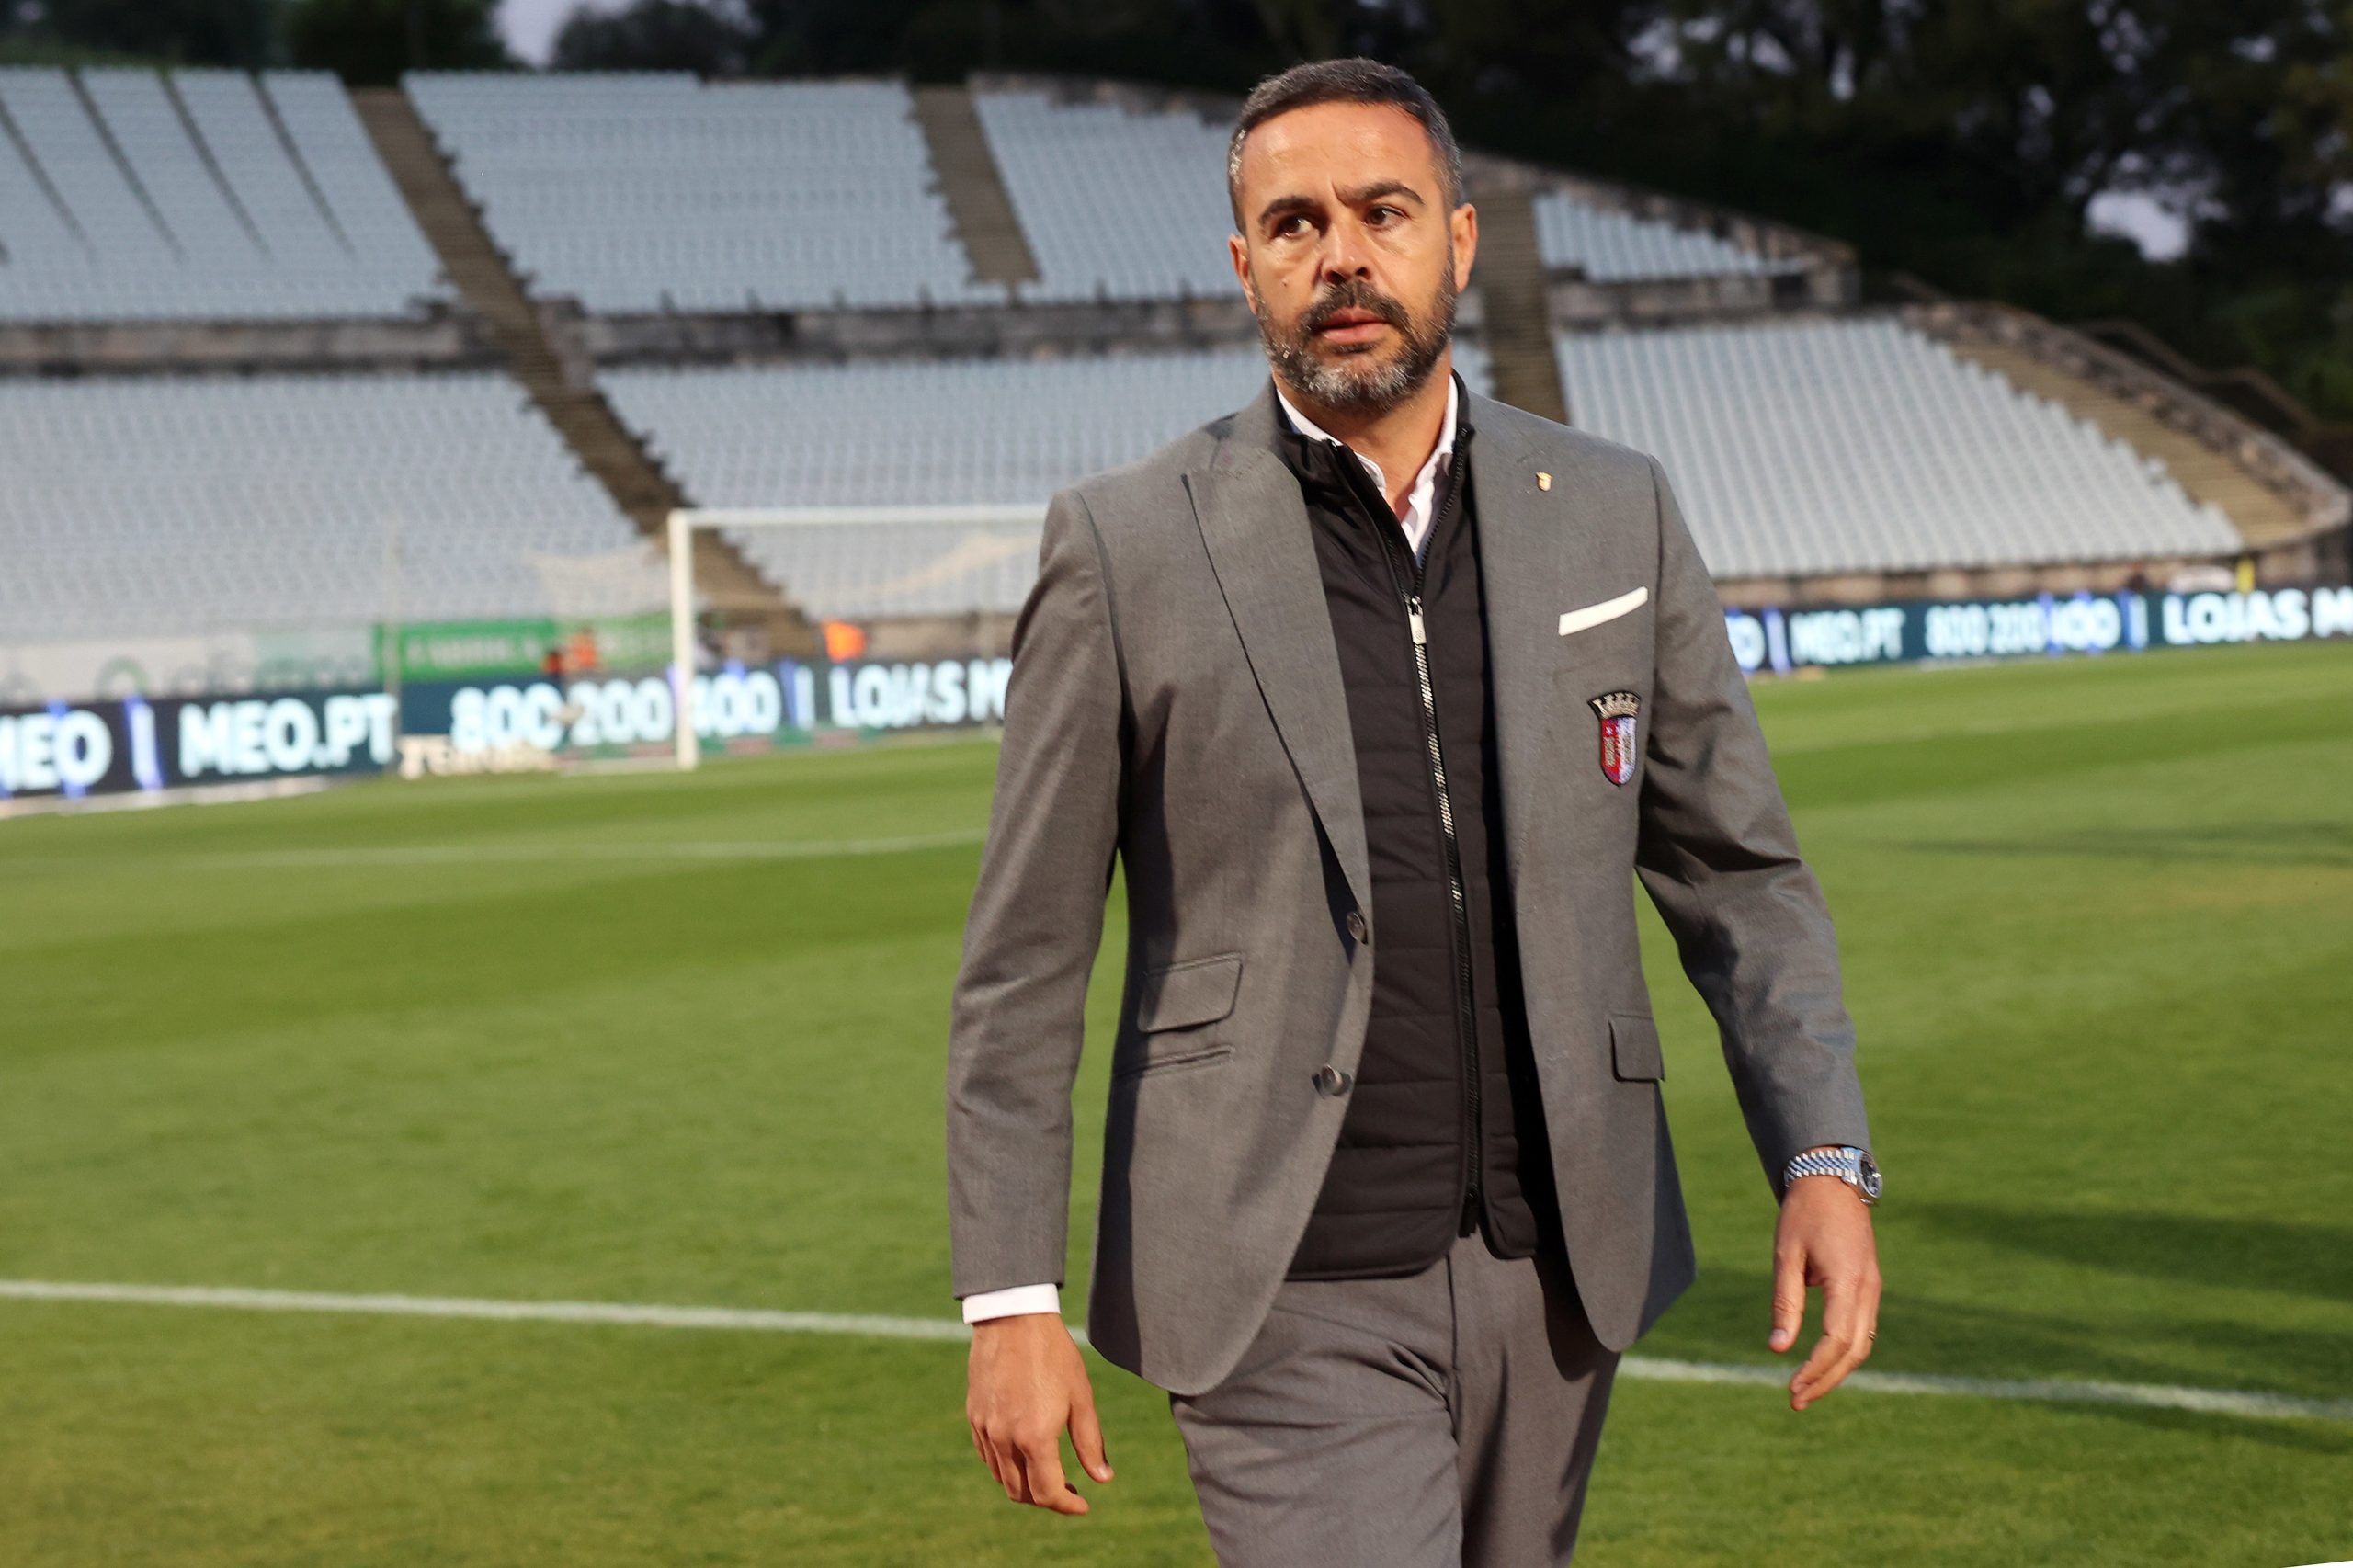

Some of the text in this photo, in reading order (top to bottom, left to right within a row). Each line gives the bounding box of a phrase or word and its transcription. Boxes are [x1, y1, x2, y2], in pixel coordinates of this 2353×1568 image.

[2162, 587, 2310, 645] LOJAS
[178, 692, 398, 778] MEO.PT
[449, 686, 564, 753] 800
[566, 677, 672, 746] 200
